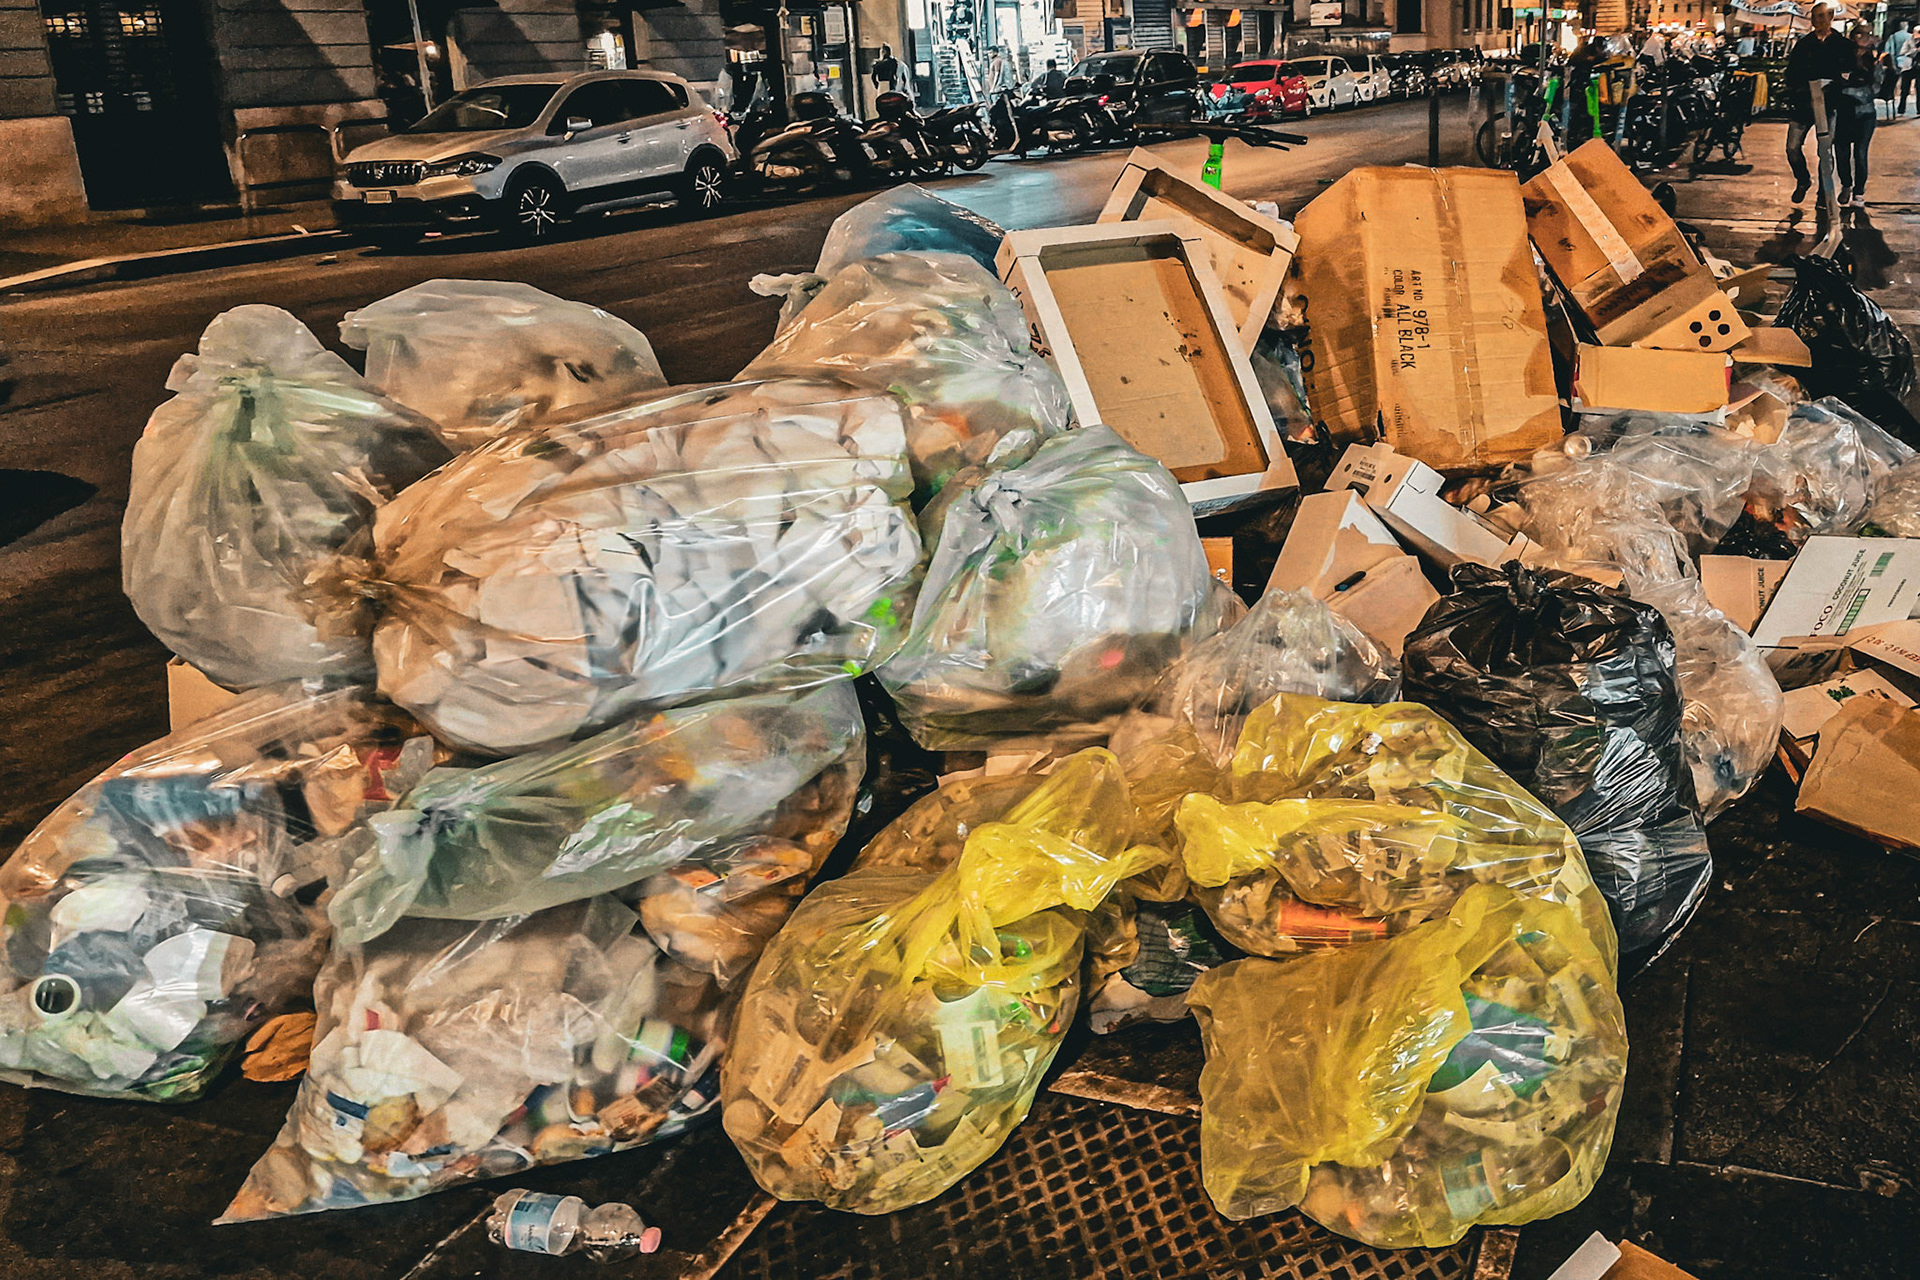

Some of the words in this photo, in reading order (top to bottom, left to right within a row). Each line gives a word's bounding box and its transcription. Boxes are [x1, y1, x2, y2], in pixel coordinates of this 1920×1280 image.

[1411, 269, 1422, 286] ART
[1397, 304, 1411, 325] ALL
[1413, 310, 1430, 348] 978-1
[1398, 329, 1416, 369] BLACK
[1757, 567, 1765, 588] JUICE
[1832, 569, 1854, 600] COCONUT
[1851, 549, 1866, 567] JUICE
